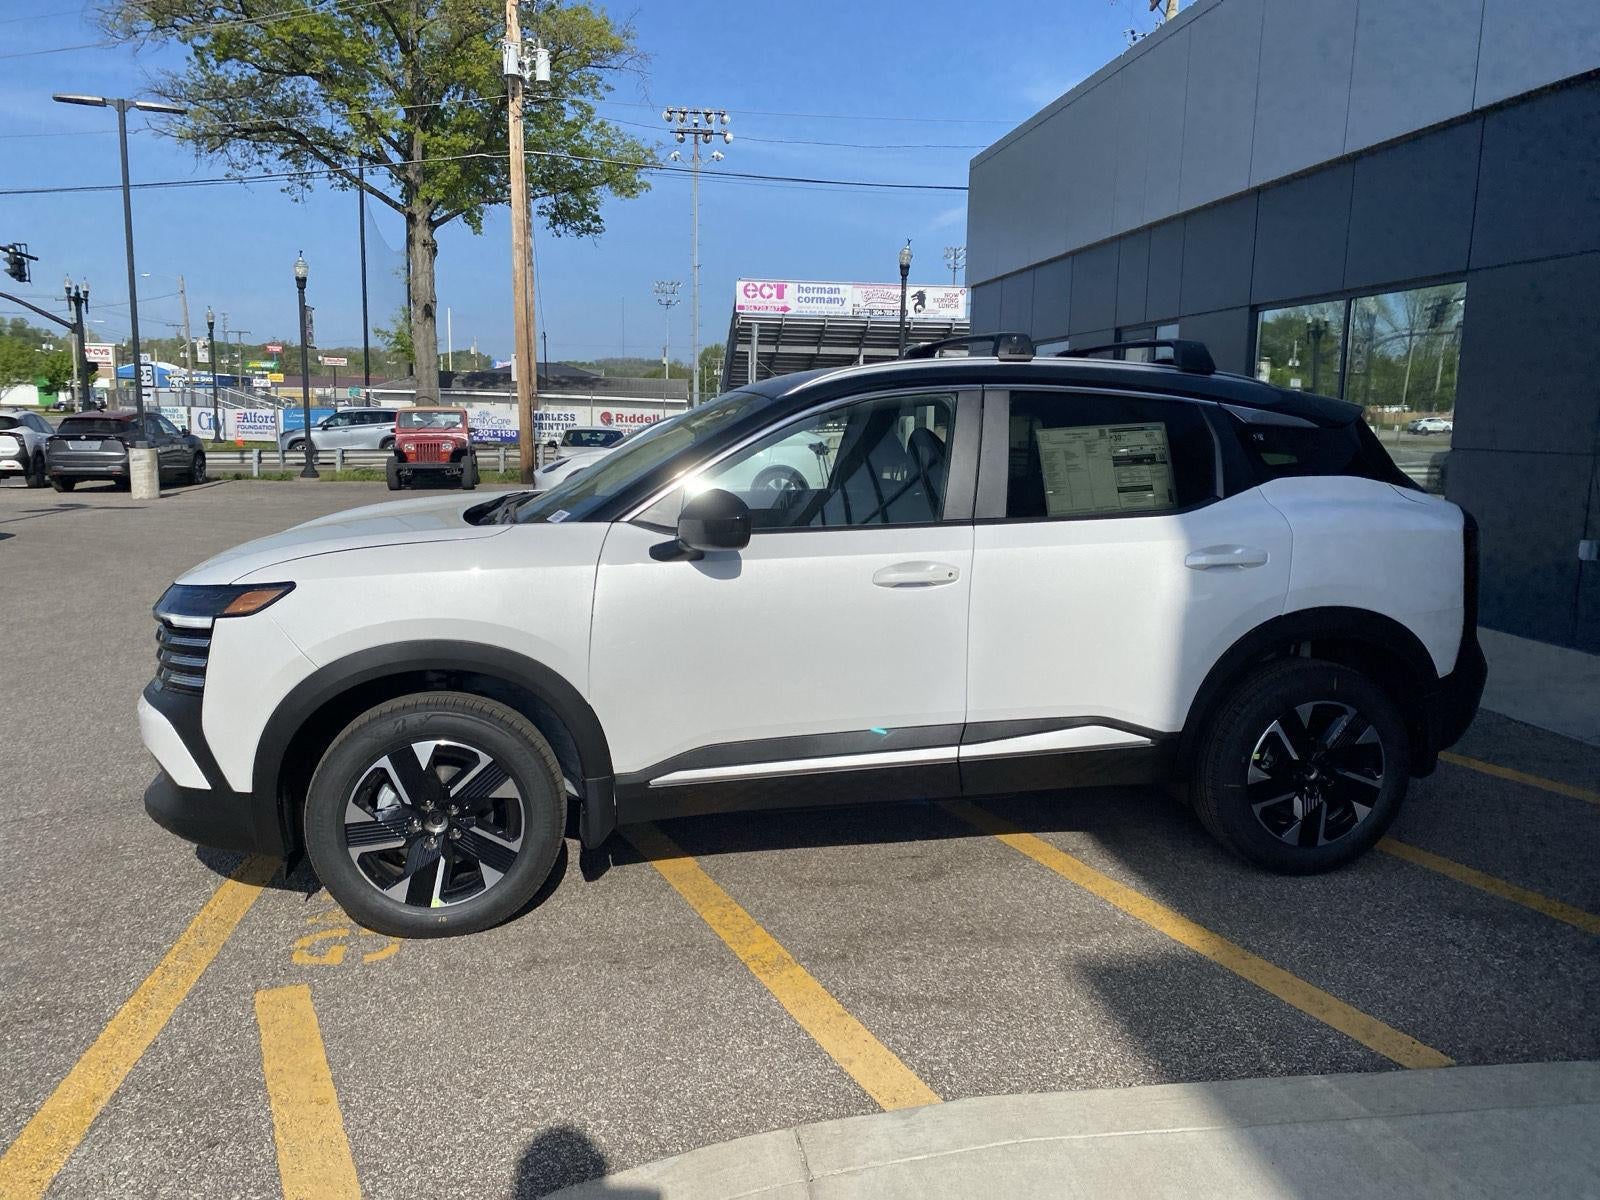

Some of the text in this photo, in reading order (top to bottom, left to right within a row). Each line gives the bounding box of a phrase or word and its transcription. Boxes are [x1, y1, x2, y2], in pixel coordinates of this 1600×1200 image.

[797, 284, 841, 295] herman
[797, 296, 847, 307] cormany
[93, 348, 110, 356] CVS
[171, 379, 185, 388] 60
[615, 413, 660, 424] Riddell
